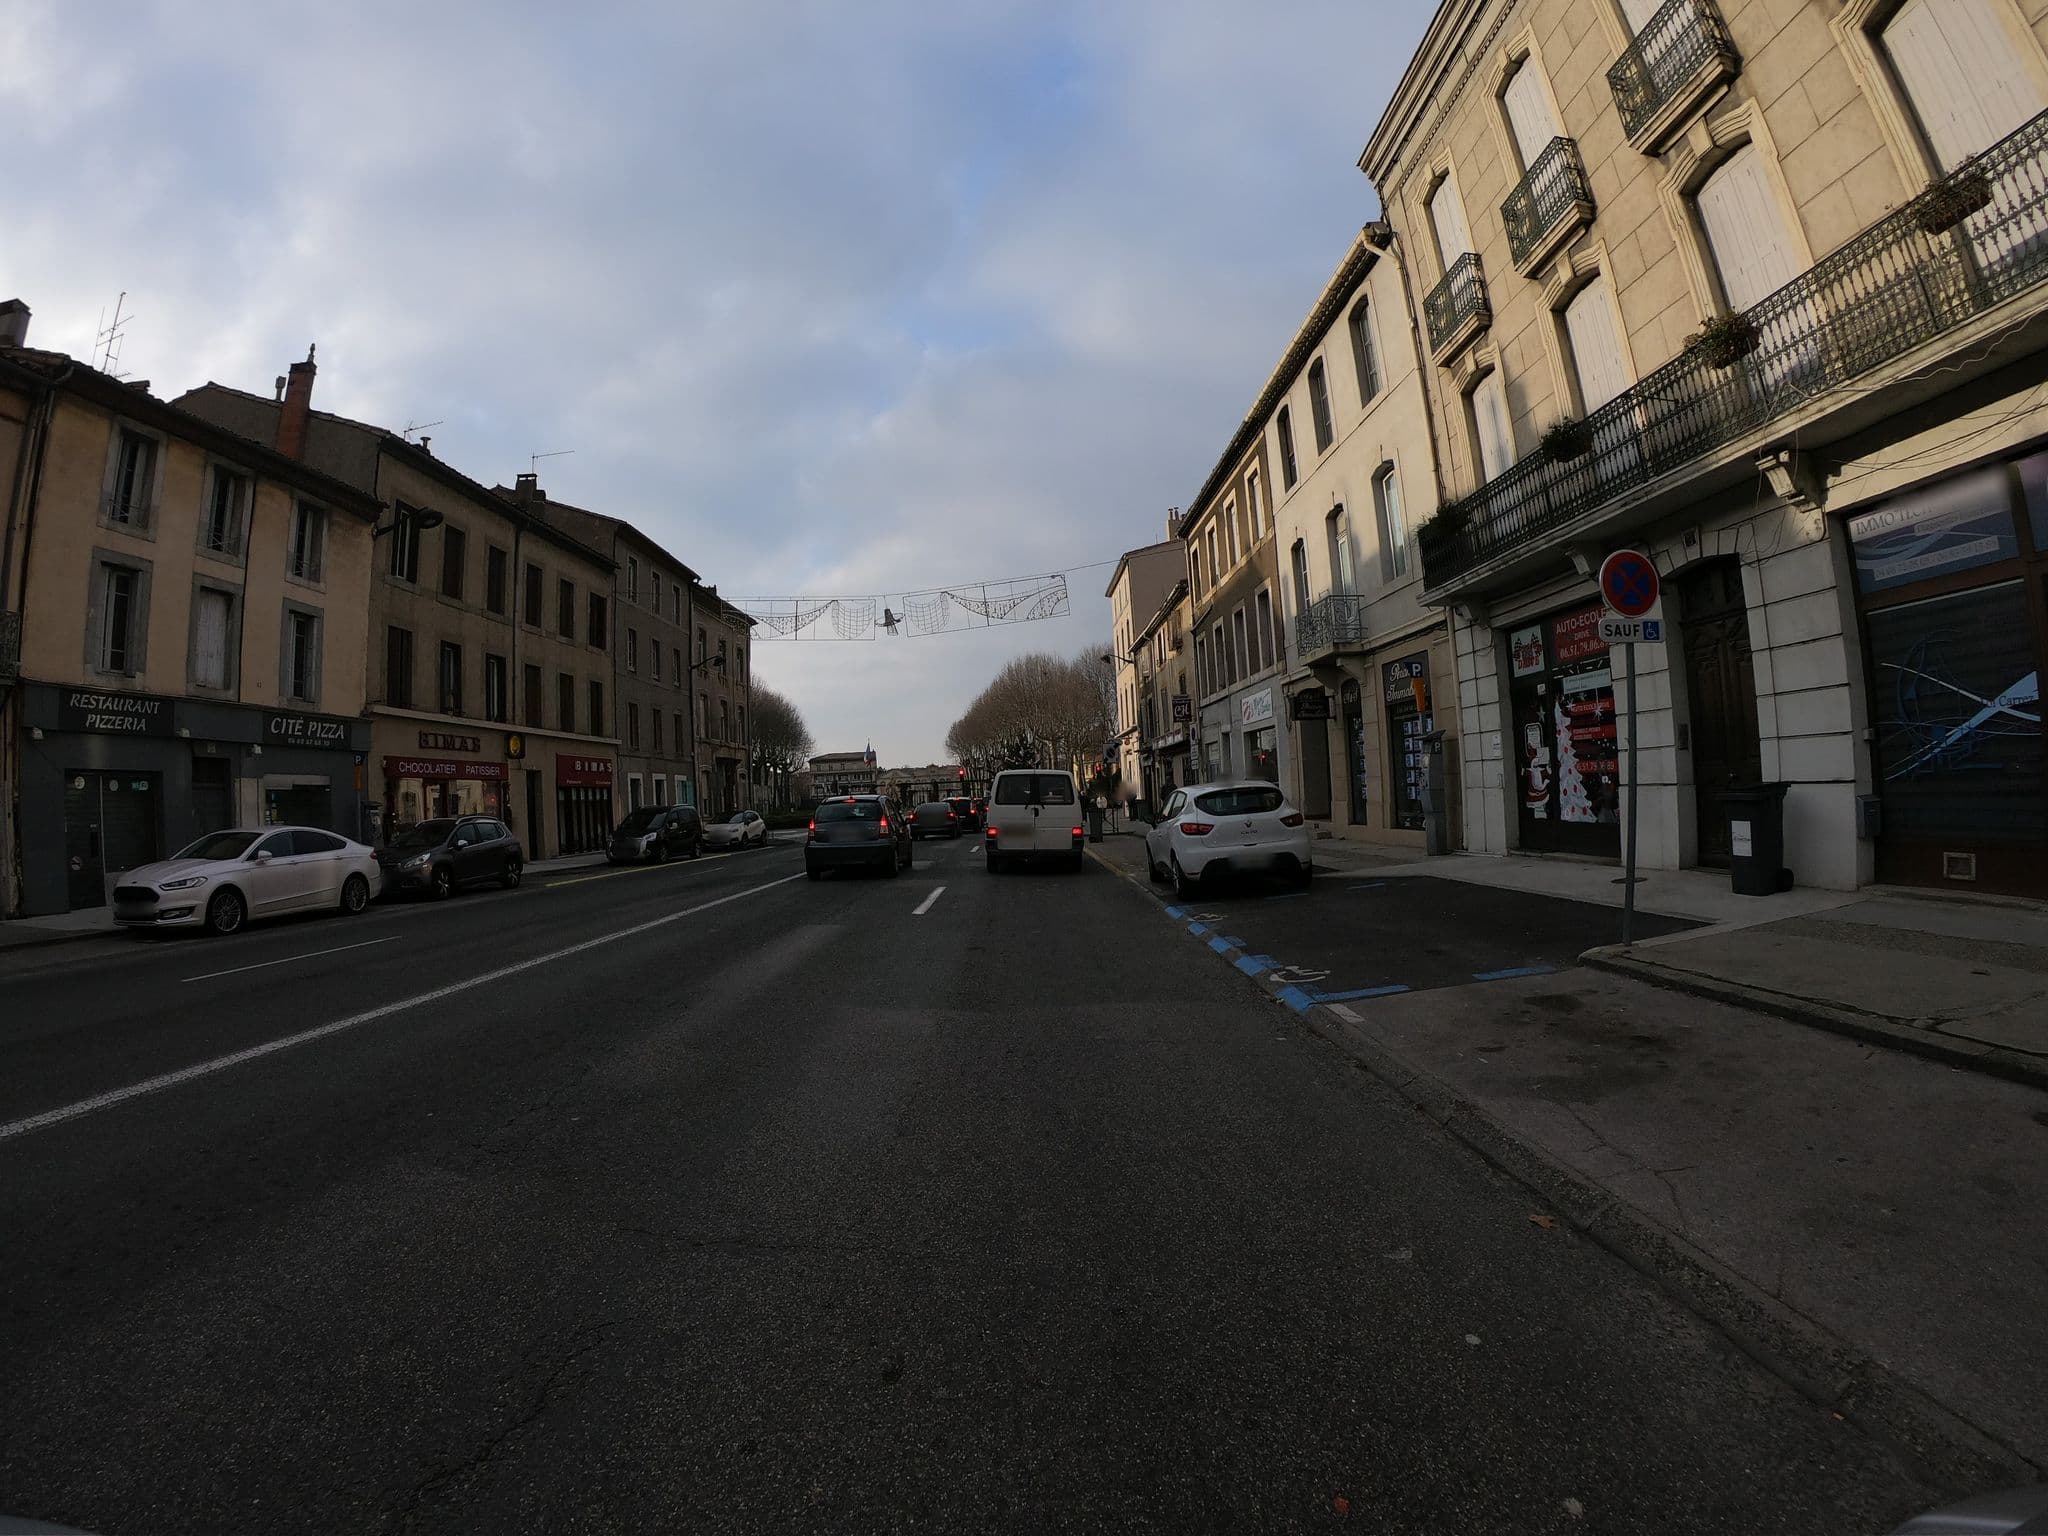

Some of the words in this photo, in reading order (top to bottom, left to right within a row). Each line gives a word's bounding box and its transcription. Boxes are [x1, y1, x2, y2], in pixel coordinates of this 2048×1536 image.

[1855, 513, 1895, 536] IMMO
[1556, 607, 1607, 634] AUTO-ECOLE
[1604, 624, 1641, 637] SAUF
[69, 693, 161, 714] RESTAURANT
[85, 714, 146, 731] PIZZERIA
[270, 716, 305, 736] CITÉ
[307, 721, 345, 740] PIZZA
[398, 761, 457, 775] CHOCOLATIER
[465, 764, 501, 776] PATISSIER
